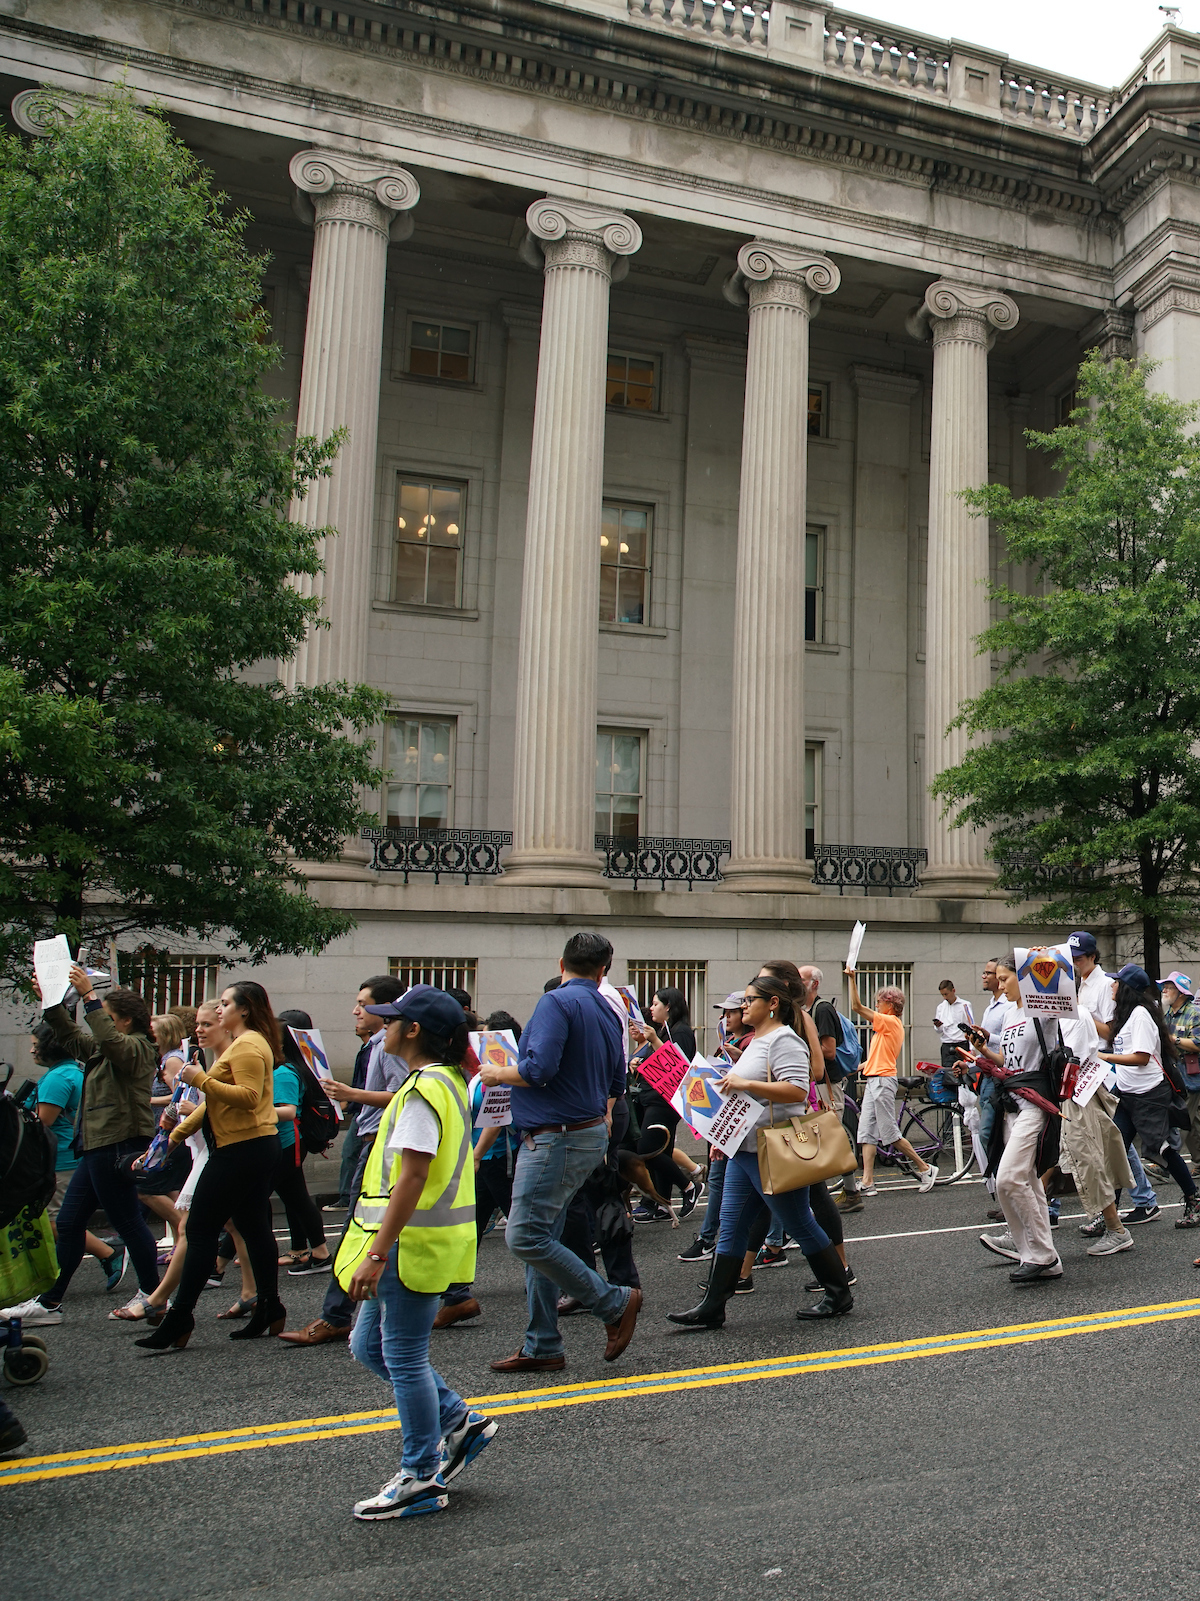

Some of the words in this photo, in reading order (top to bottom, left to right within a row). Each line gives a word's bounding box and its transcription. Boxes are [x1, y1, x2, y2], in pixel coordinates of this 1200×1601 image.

[1002, 1025, 1025, 1041] ERE
[1002, 1042, 1015, 1056] TO
[1090, 1062, 1101, 1075] TPS
[483, 1106, 500, 1114] DACA
[710, 1119, 722, 1133] WILL
[719, 1093, 738, 1118] DEFEND
[713, 1099, 745, 1142] IMMIGRANTS,
[719, 1124, 736, 1147] DACA
[737, 1101, 751, 1117] TPS
